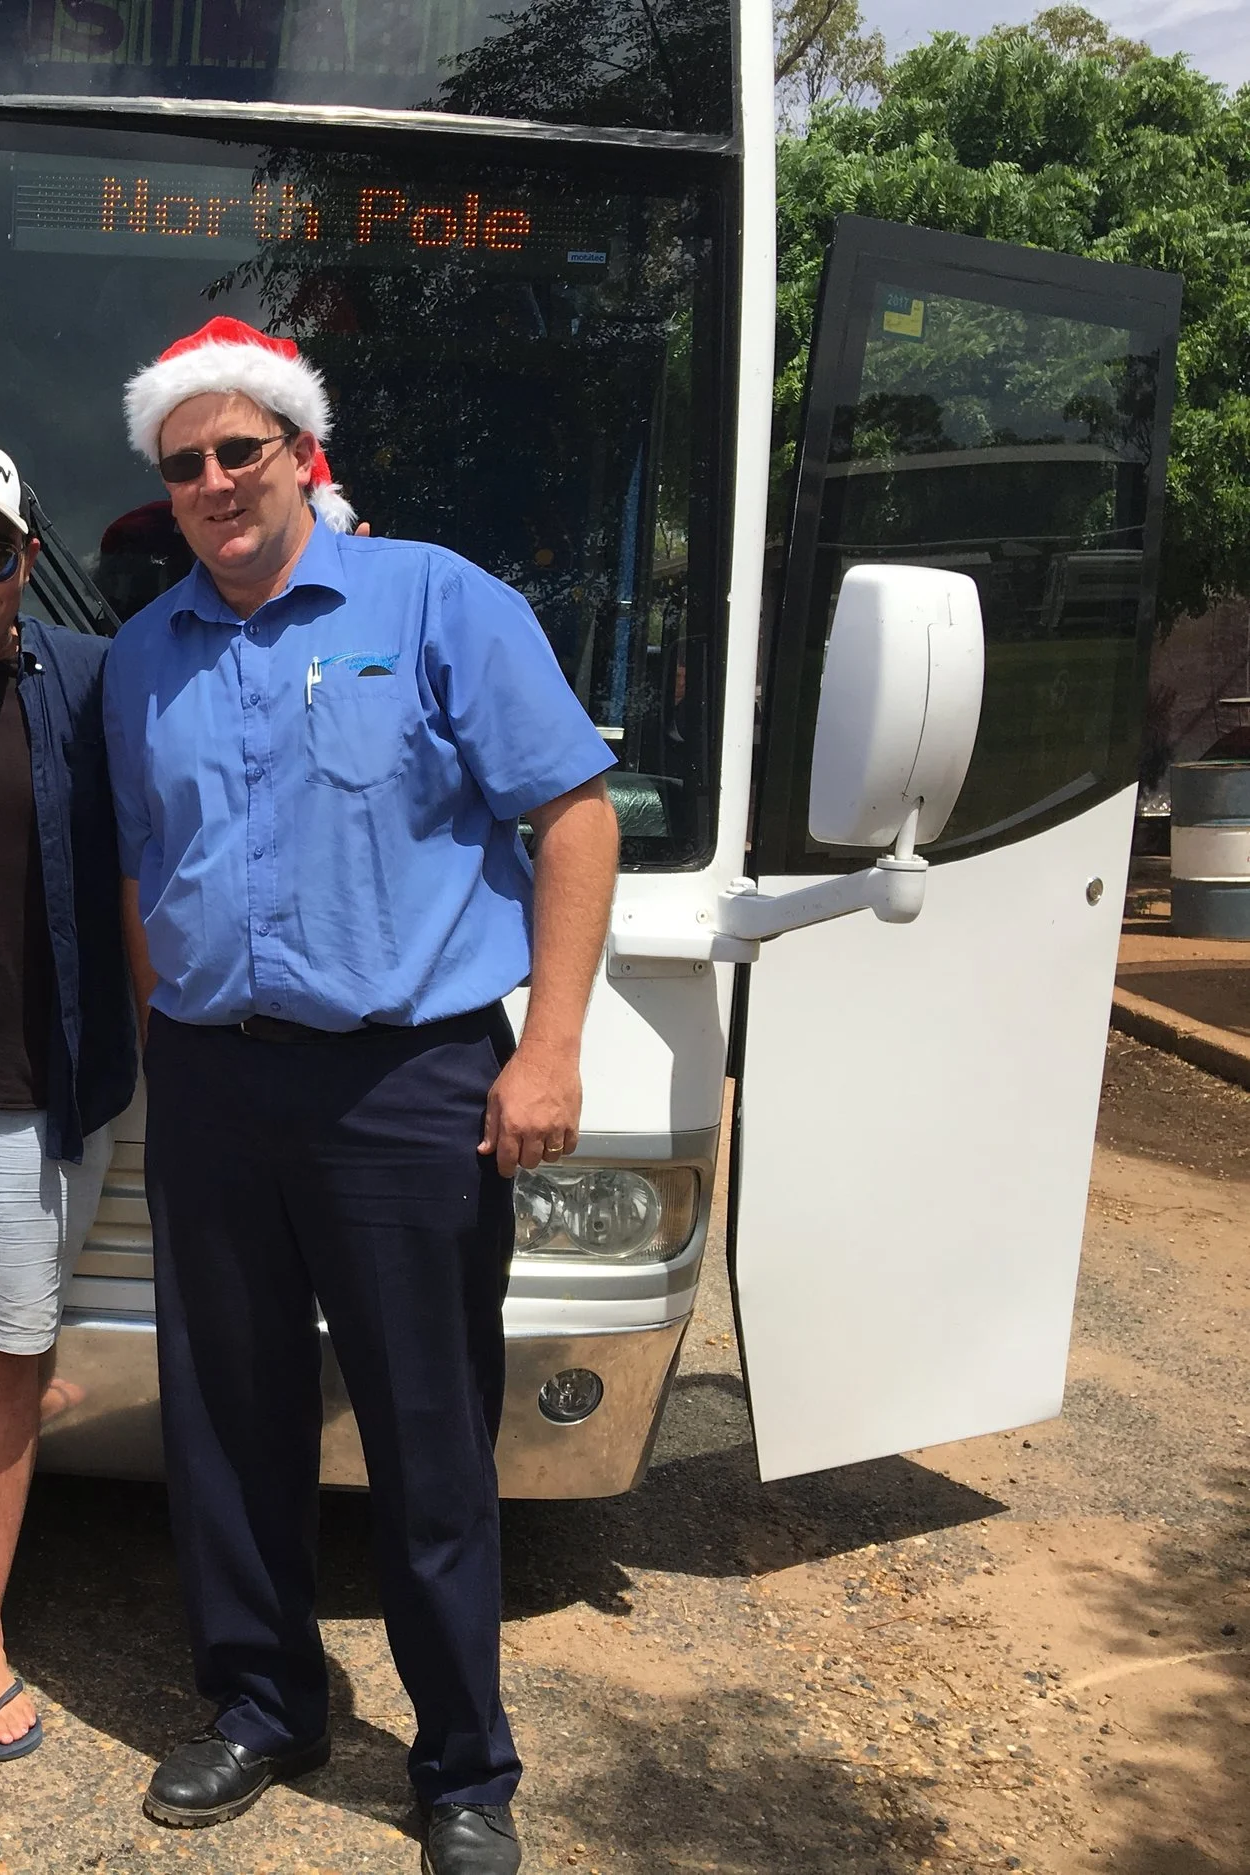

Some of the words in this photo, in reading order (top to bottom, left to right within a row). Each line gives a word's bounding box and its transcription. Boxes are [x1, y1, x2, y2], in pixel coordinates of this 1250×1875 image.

[101, 176, 319, 241] North
[359, 188, 530, 250] Pole
[570, 253, 605, 262] mobitec
